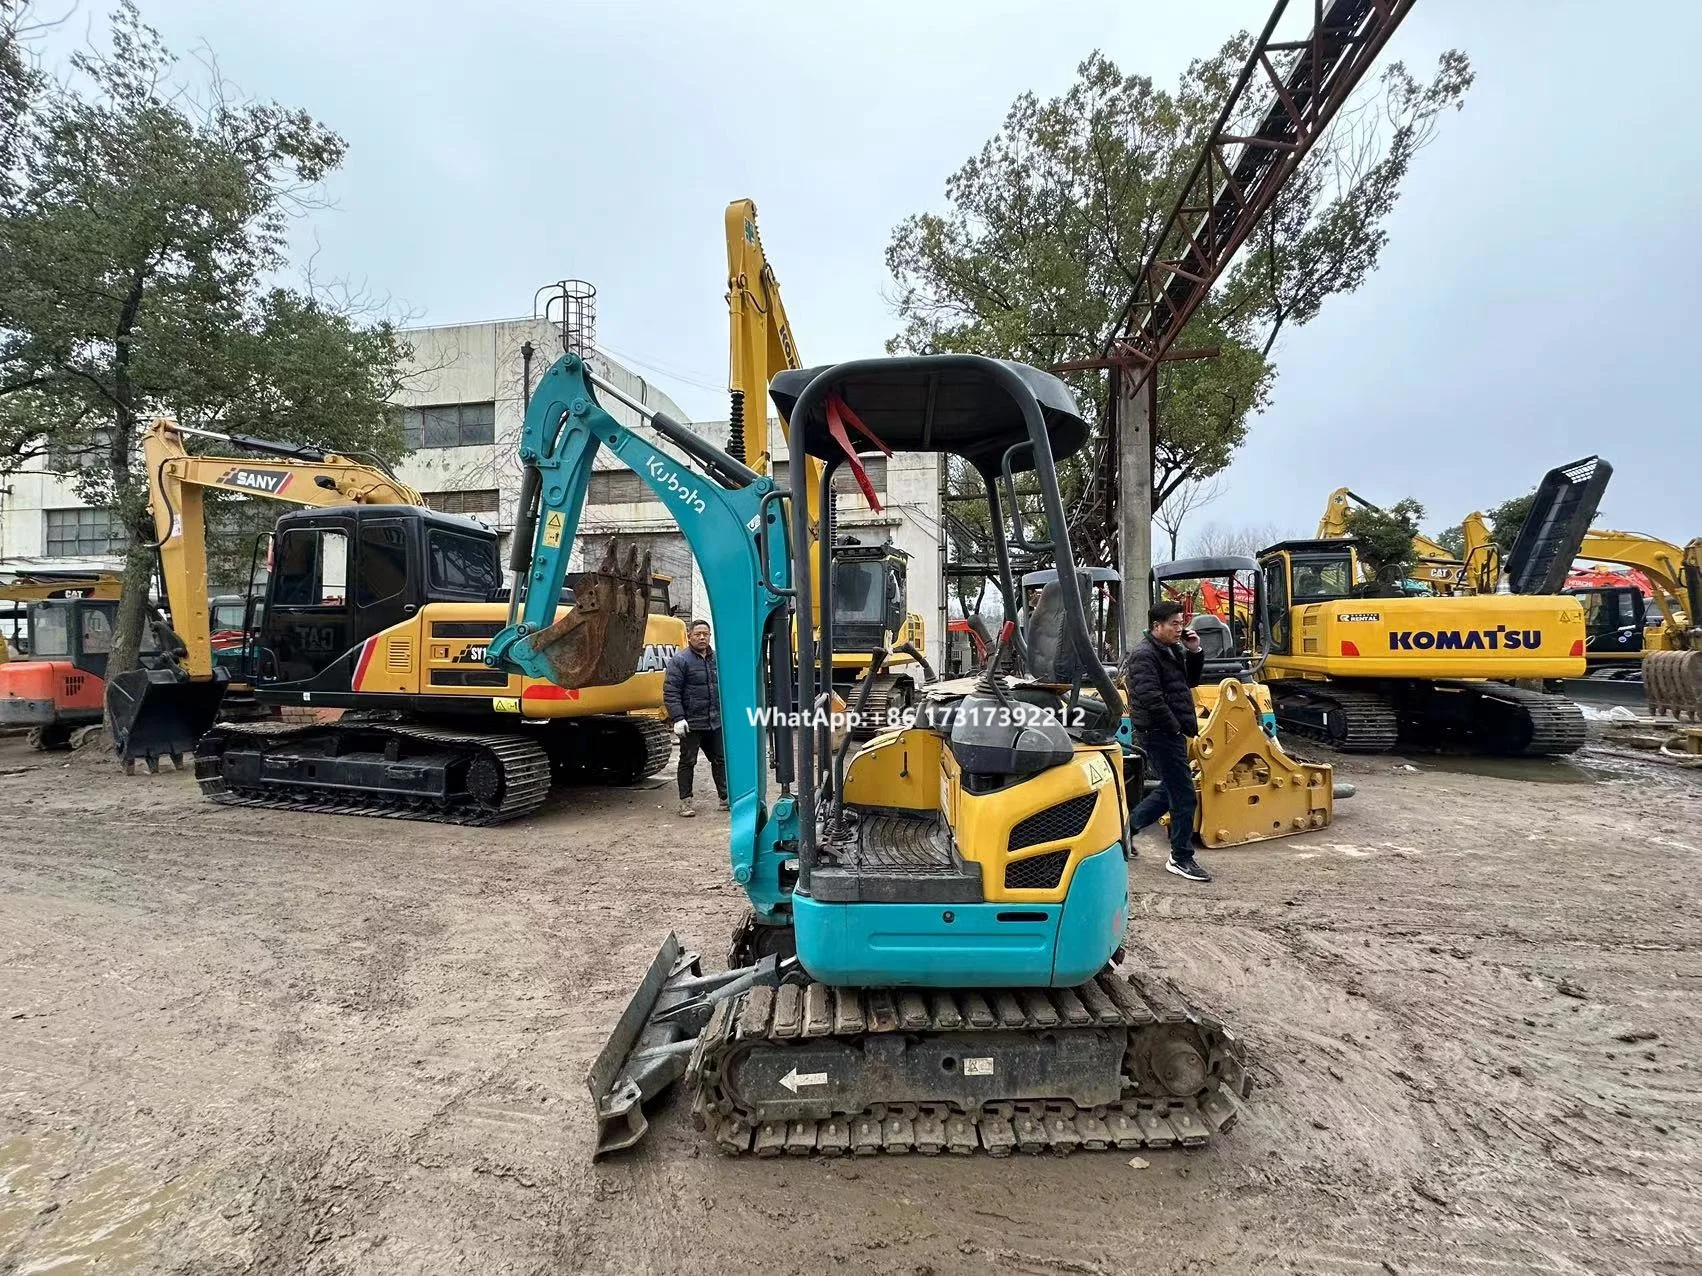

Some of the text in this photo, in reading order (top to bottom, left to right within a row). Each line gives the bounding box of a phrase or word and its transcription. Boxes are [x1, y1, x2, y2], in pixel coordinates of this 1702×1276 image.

[237, 472, 277, 490] SANY
[645, 455, 706, 514] Kubota
[1430, 568, 1448, 578] CAT
[65, 590, 84, 598] CAT
[1388, 624, 1542, 650] KOMATSU
